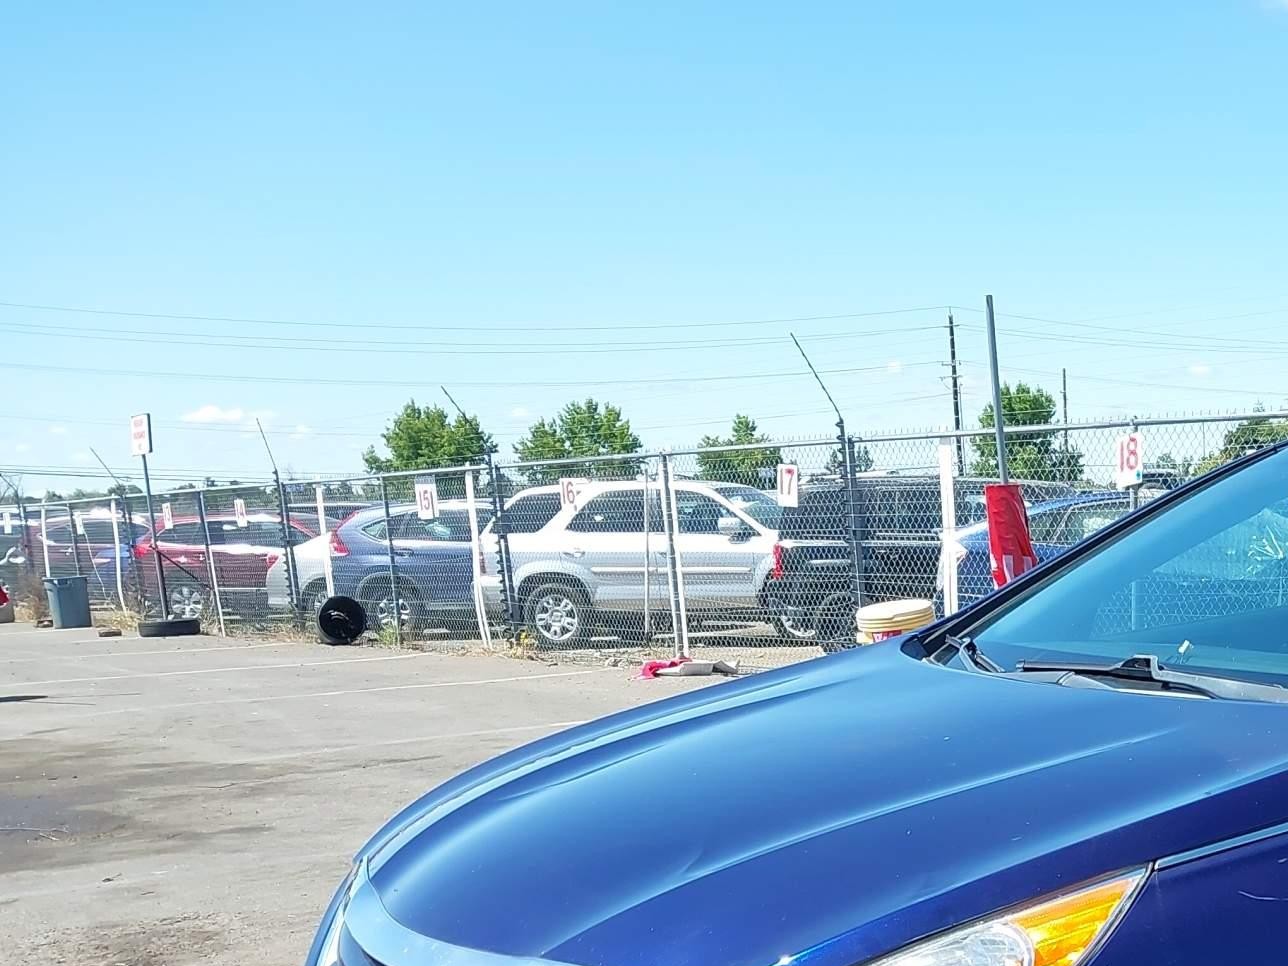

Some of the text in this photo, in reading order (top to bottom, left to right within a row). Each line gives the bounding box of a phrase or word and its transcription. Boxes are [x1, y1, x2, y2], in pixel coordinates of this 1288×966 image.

[1120, 437, 1139, 472] 18
[561, 480, 576, 505] 16
[780, 467, 795, 495] 17
